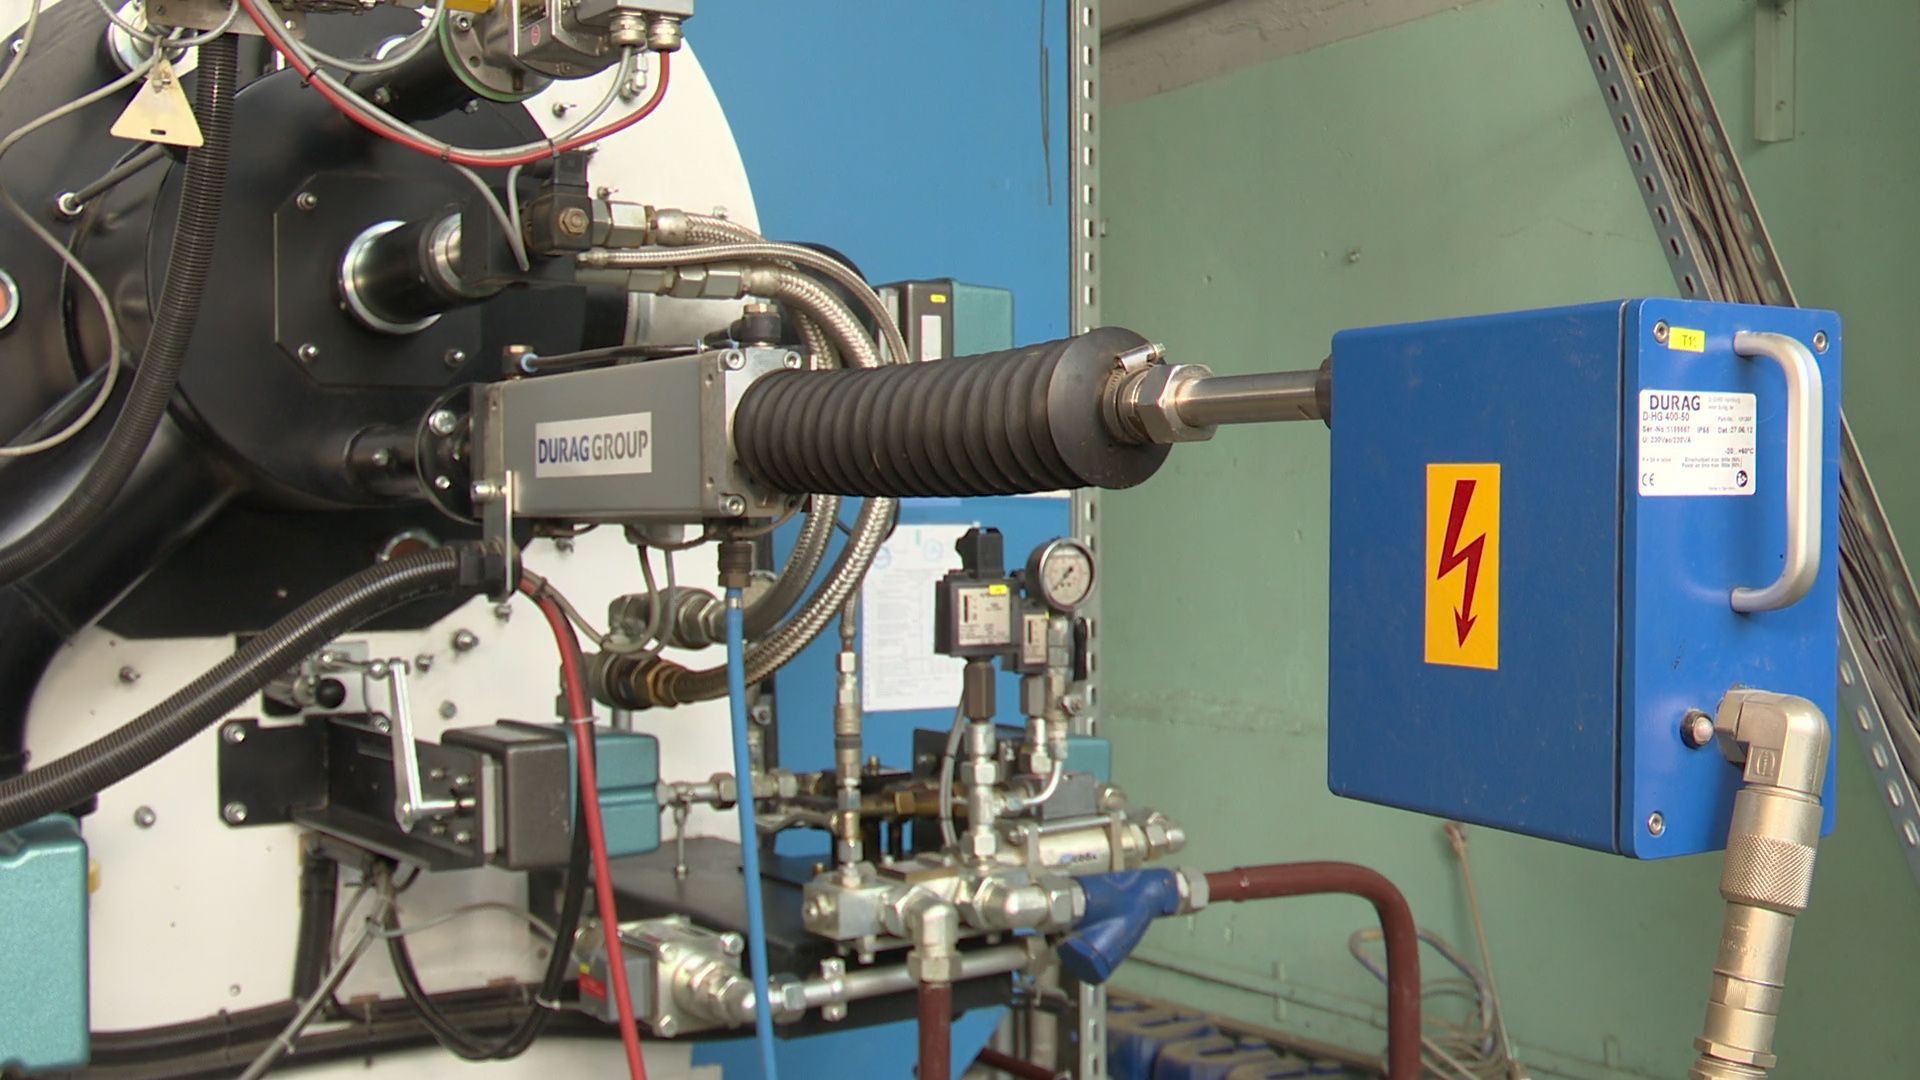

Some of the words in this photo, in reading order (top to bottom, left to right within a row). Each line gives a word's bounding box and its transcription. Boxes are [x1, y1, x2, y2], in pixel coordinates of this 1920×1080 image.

[1649, 394, 1701, 411] DURAG
[1642, 411, 1663, 422] D-HG
[1665, 411, 1690, 422] 400-50
[538, 434, 590, 464] DURAG
[591, 429, 649, 462] GROUP
